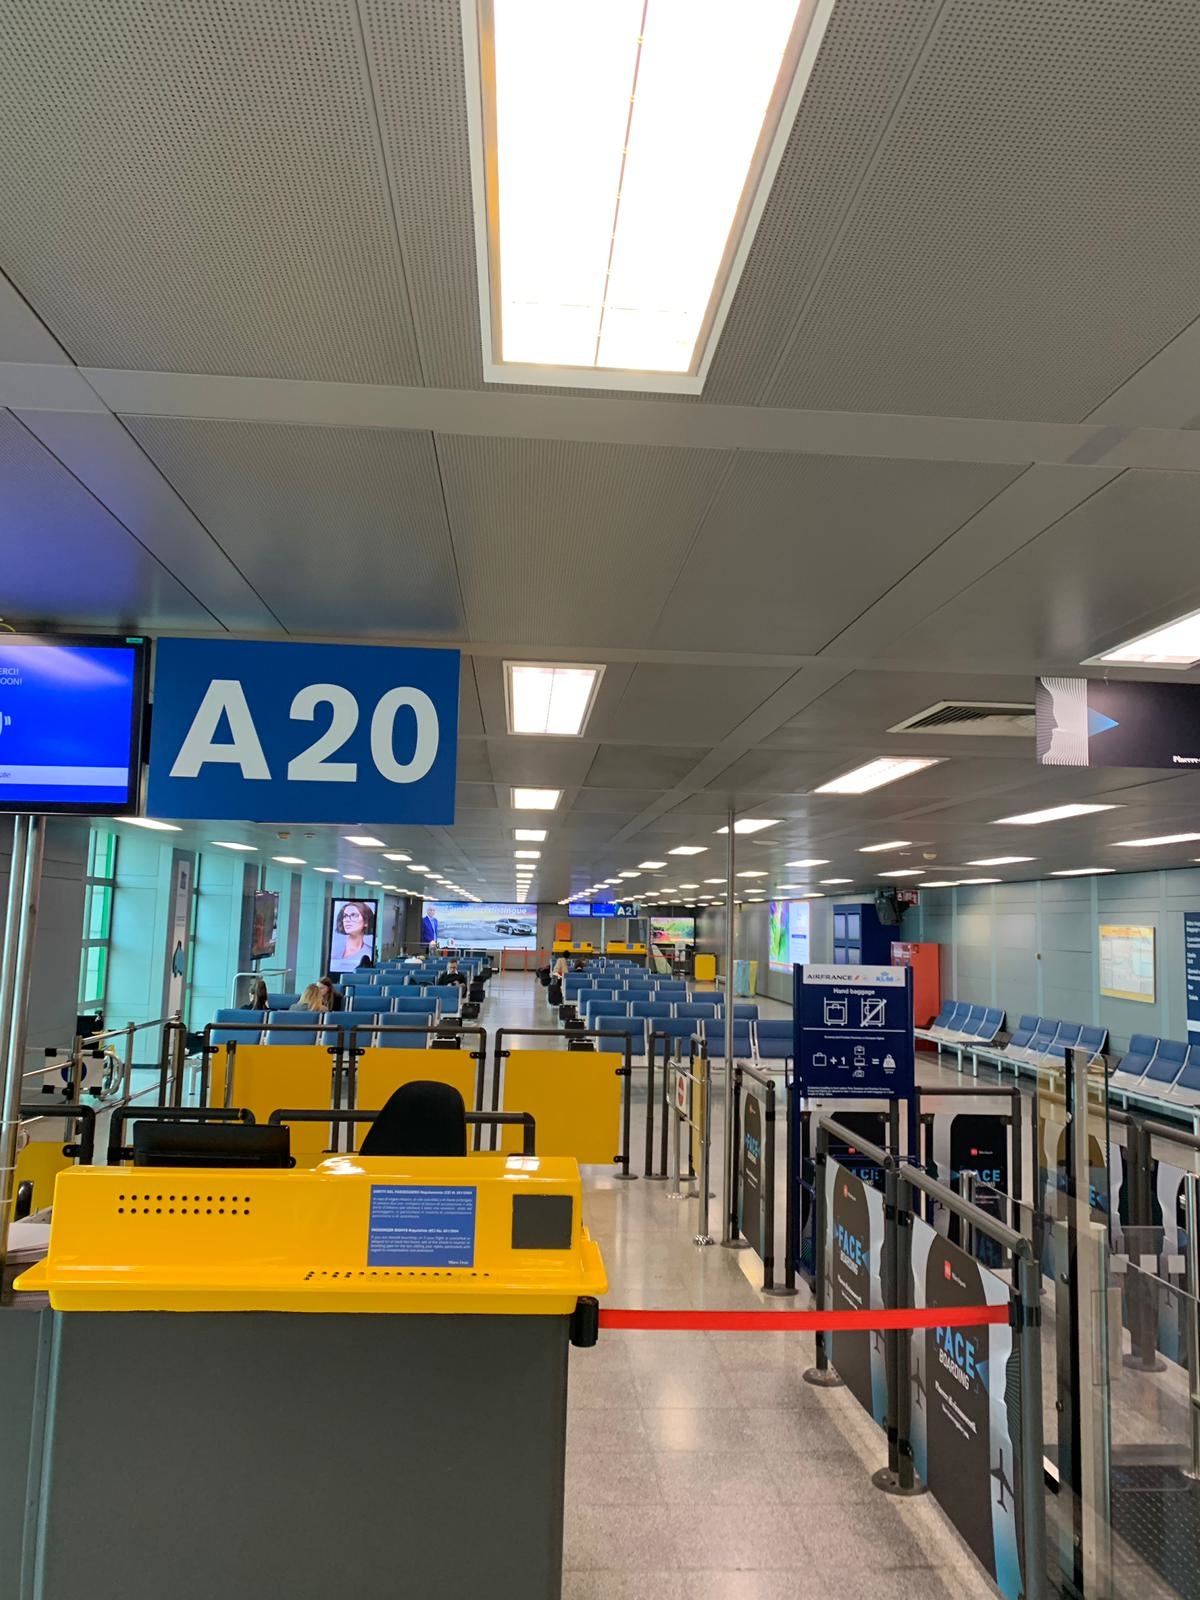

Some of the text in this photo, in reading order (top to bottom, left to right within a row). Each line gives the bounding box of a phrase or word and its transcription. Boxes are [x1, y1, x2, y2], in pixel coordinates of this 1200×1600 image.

[169, 678, 440, 784] A20
[617, 906, 637, 916] A21
[850, 988, 876, 996] baggage
[838, 1224, 862, 1266] FACE
[938, 1348, 970, 1391] BOARDING
